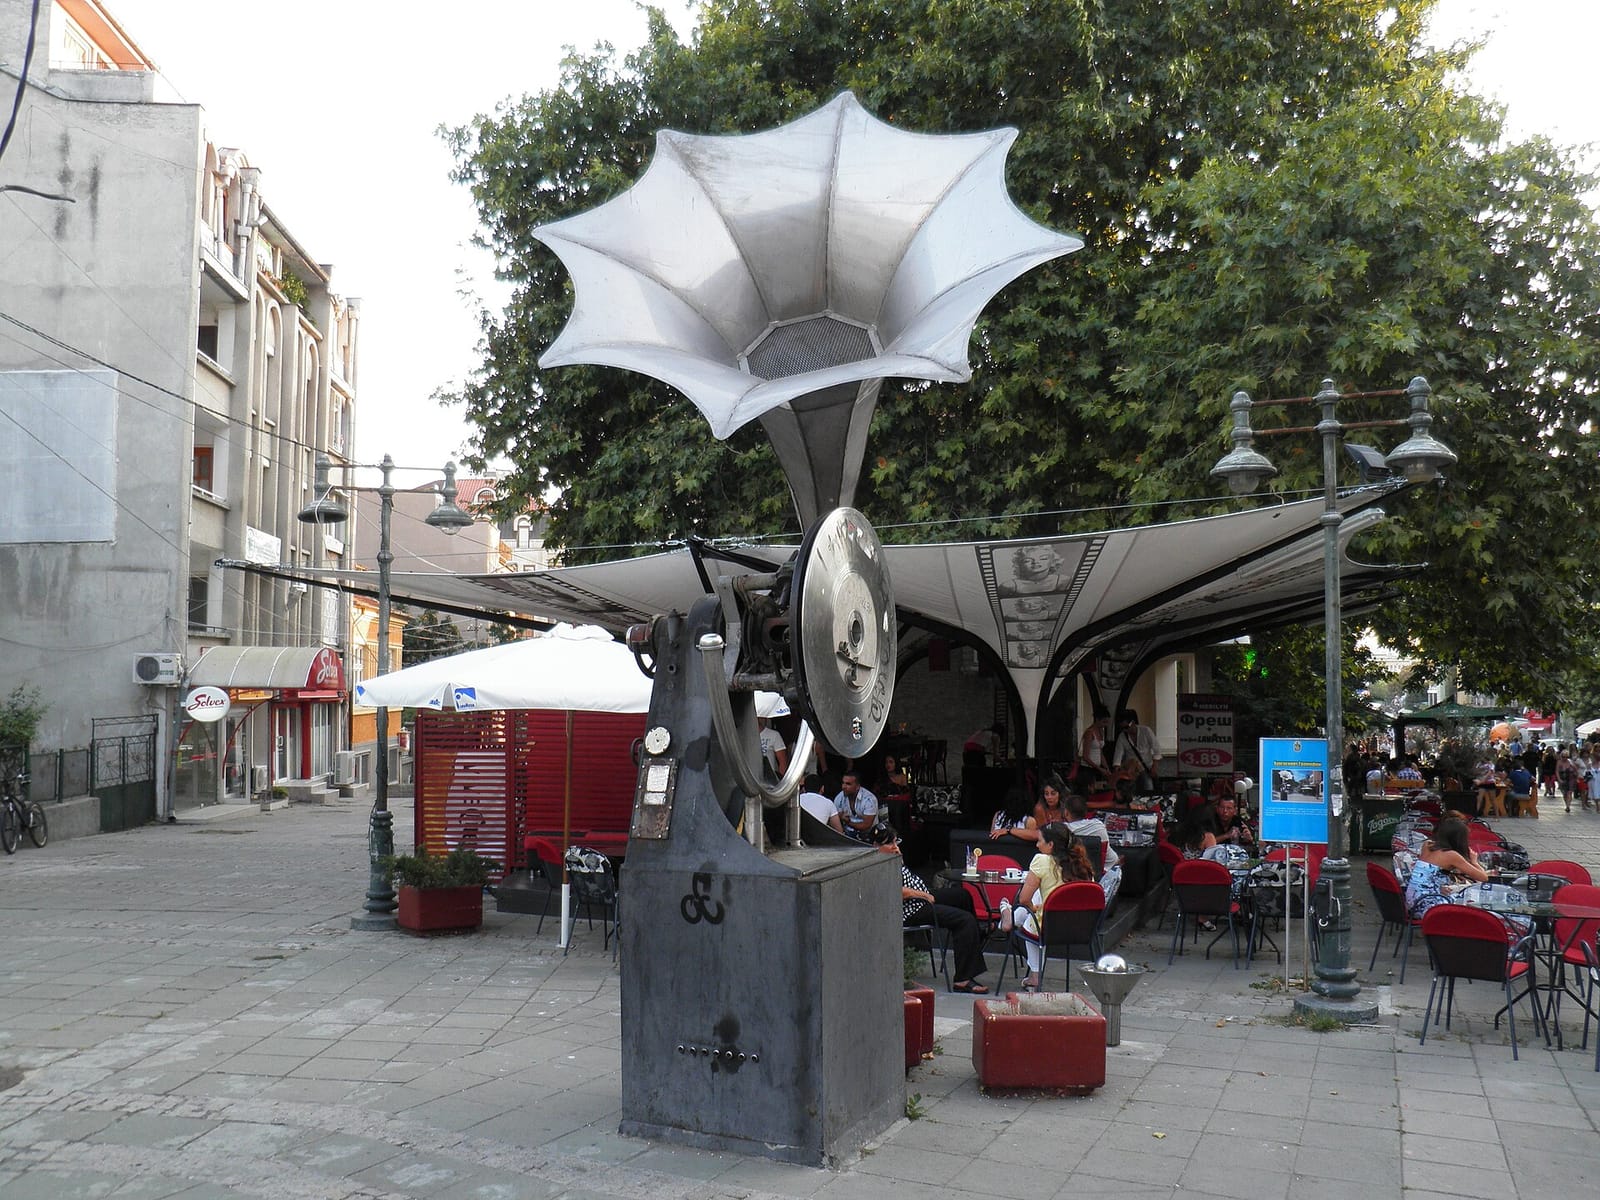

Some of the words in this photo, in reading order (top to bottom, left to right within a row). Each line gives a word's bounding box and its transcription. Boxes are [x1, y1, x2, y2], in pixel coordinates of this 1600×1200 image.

[187, 694, 225, 711] Solvex
[1180, 713, 1232, 729] Фреш
[1184, 752, 1221, 766] 3.89
